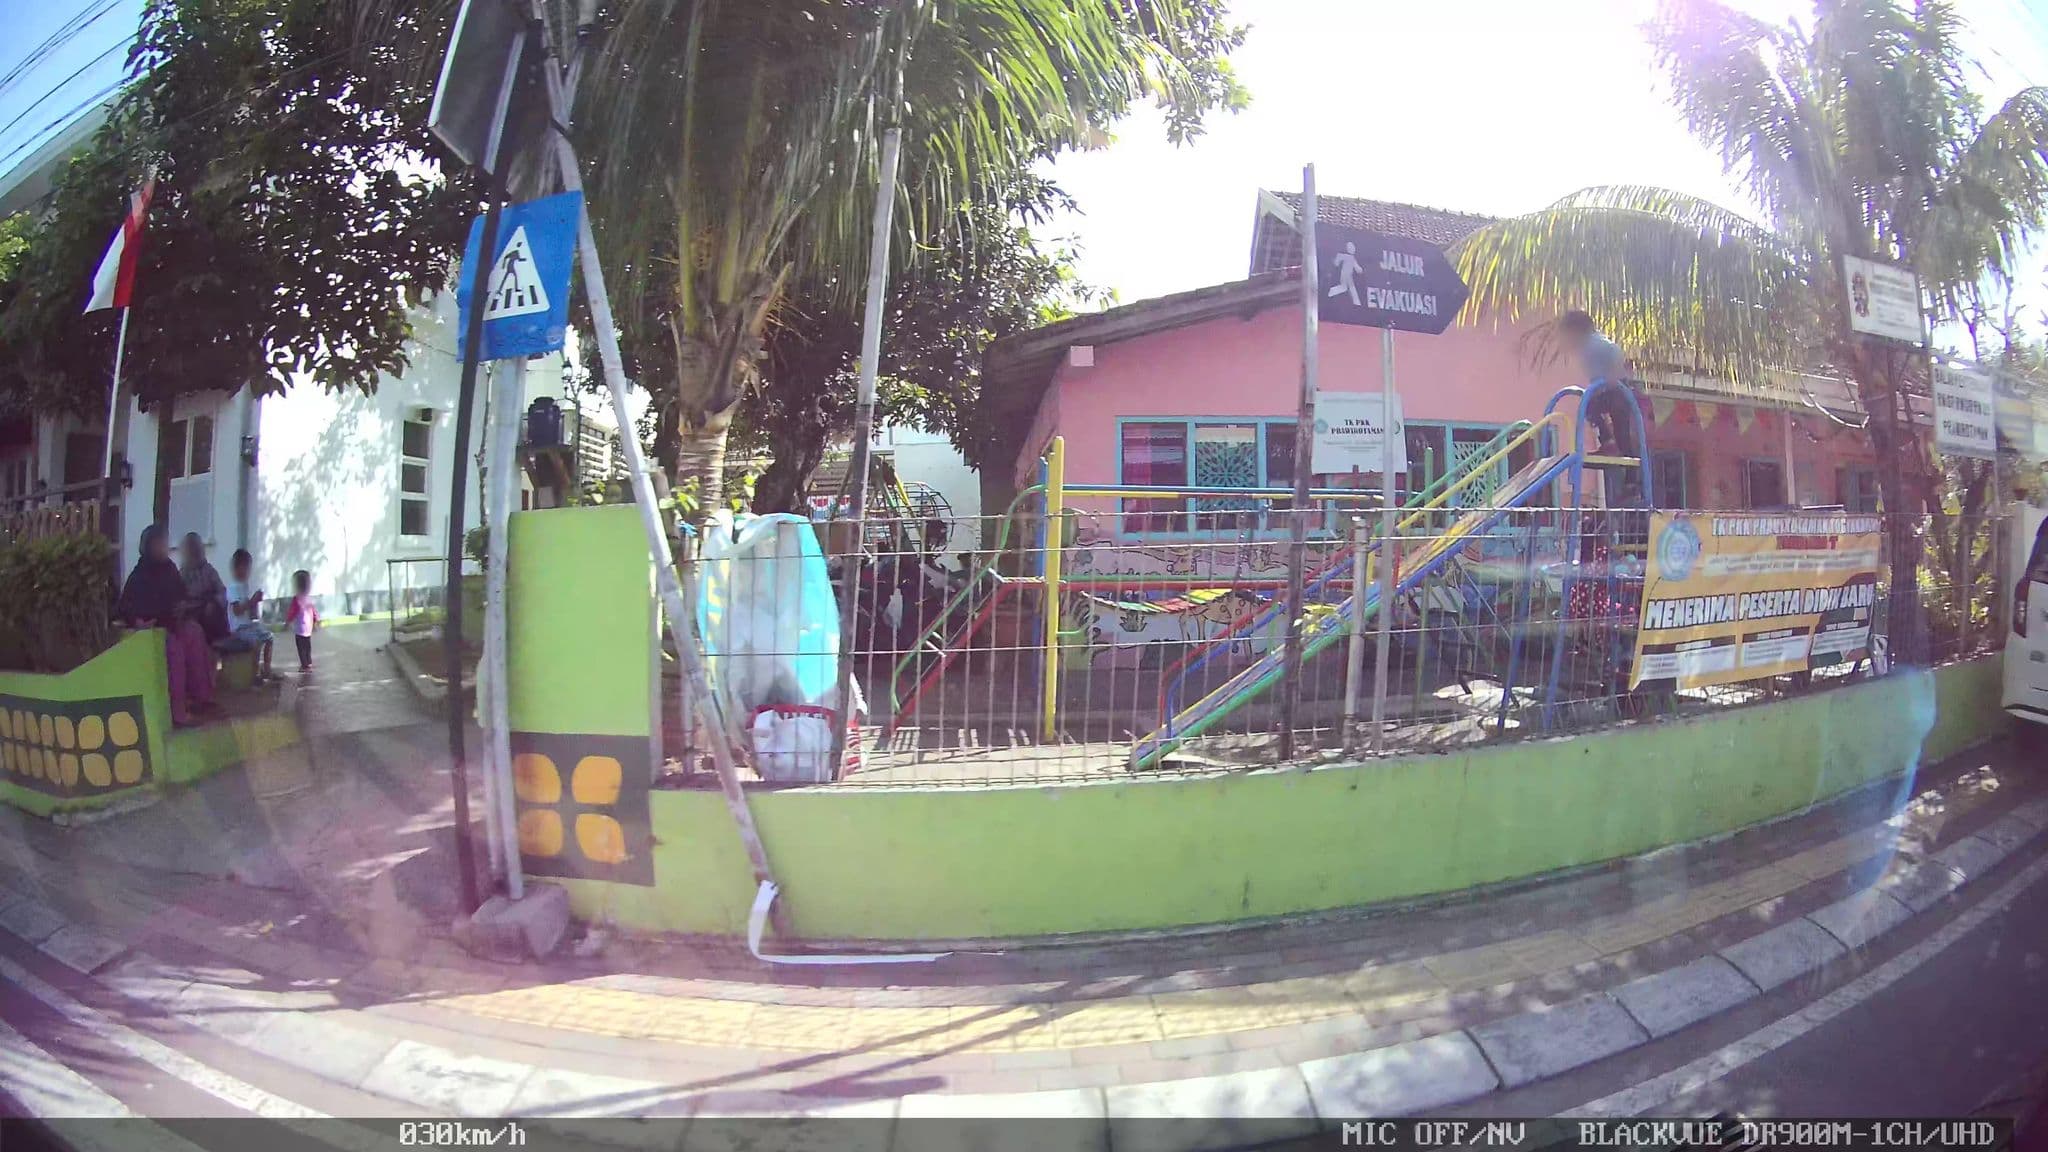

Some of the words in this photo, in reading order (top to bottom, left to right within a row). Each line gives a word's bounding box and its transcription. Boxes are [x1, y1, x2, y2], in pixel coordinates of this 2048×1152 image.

[1380, 250, 1424, 277] JALUR
[1367, 286, 1437, 316] EVAKUASI
[1643, 593, 1736, 630] MENERIMA
[1738, 589, 1801, 621] PESERTA
[1803, 585, 1843, 614] DIDIK
